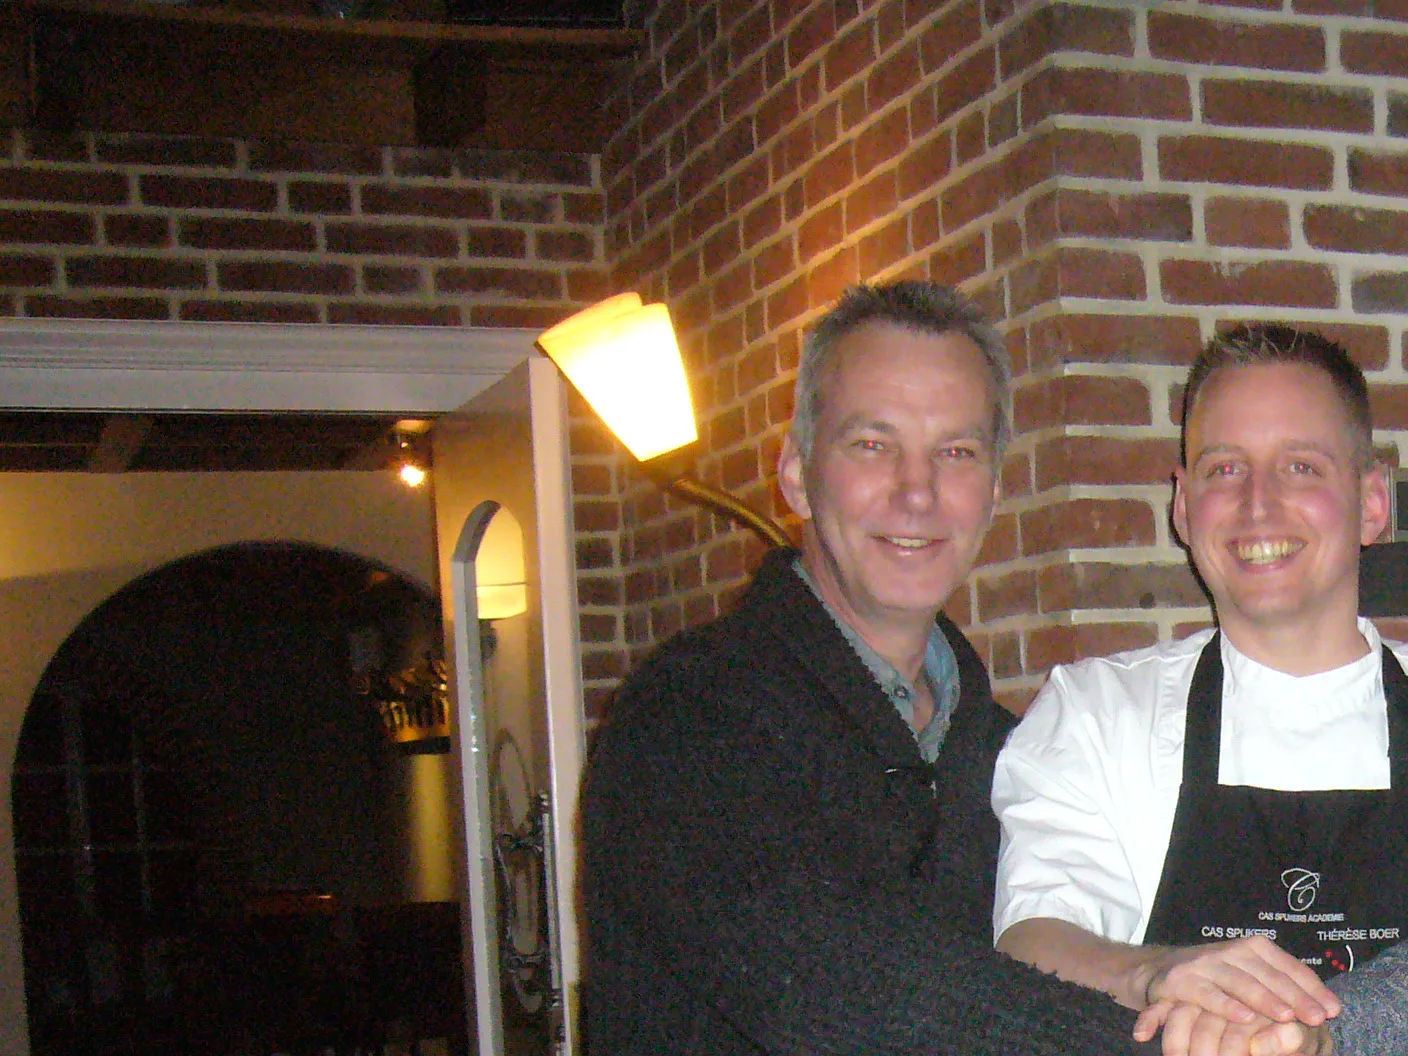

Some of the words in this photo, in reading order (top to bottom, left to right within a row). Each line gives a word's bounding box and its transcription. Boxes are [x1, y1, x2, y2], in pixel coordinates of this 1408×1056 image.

[1258, 911, 1274, 921] CAS
[1201, 925, 1224, 938] CAS
[1316, 927, 1367, 941] THÉRÈSE
[1369, 927, 1400, 940] BOER
